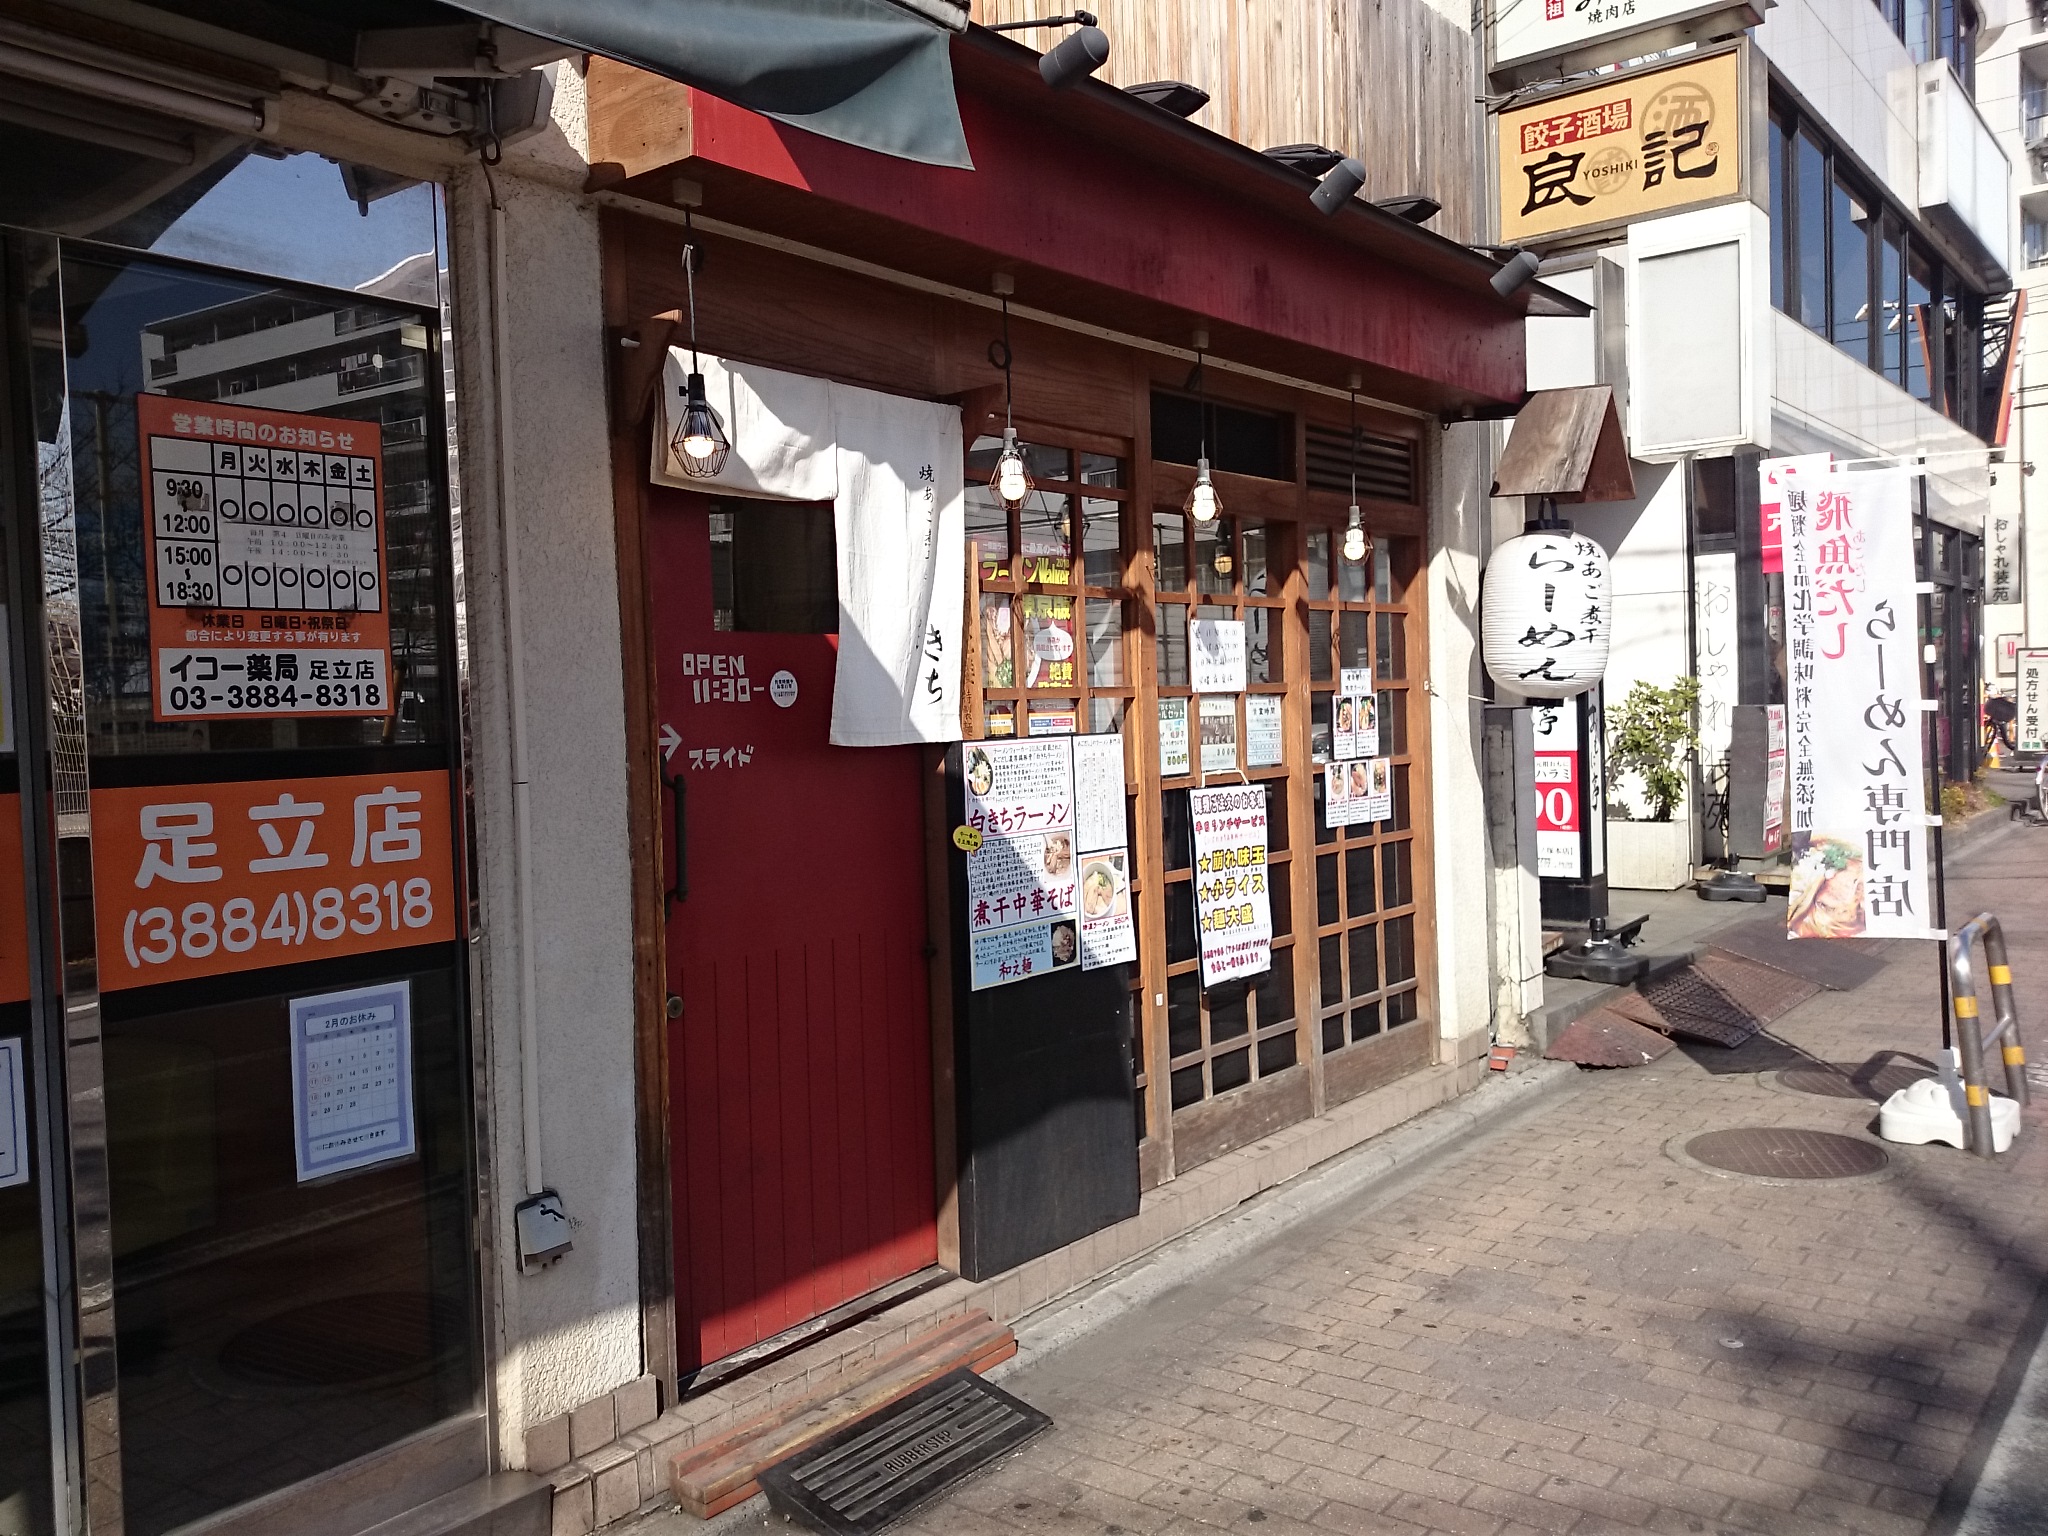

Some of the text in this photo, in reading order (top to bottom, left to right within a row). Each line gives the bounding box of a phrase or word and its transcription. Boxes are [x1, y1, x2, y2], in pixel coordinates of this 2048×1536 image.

[1588, 2, 1636, 24] 焼肉店
[1523, 102, 1630, 151] 餃子酒場
[1583, 159, 1639, 181] YOSHIKI
[171, 413, 355, 451] 営業時間のお知らせ
[220, 451, 372, 483] 月 火 水 木 金 土
[162, 514, 210, 534] 12:00
[164, 546, 212, 566] 15:00
[1993, 517, 2011, 602] おしゃれ装苑
[166, 581, 214, 602] 18:30
[1574, 541, 1602, 645] 焼あご煮干
[202, 614, 244, 629] 休業日
[1518, 545, 1577, 682] らーめん
[185, 630, 361, 643] 都合により変更する事が有ります
[170, 654, 375, 683] イコー薬局 足立店
[682, 653, 745, 676] OPEN
[170, 684, 380, 711] 03-3884-8318
[2025, 667, 2039, 739] 処方せん受付
[689, 744, 754, 771] スライド
[1535, 769, 1570, 780] ハラミ
[134, 786, 423, 889] 足立店
[1195, 815, 1265, 834] 平日ランチサービス
[1212, 845, 1265, 872] 崩れ味玉
[1211, 874, 1265, 900] 小ライス
[123, 877, 434, 969] (3884)8318
[1212, 903, 1254, 931] 麺大盛
[883, 1429, 953, 1472] RUBBER STEP
